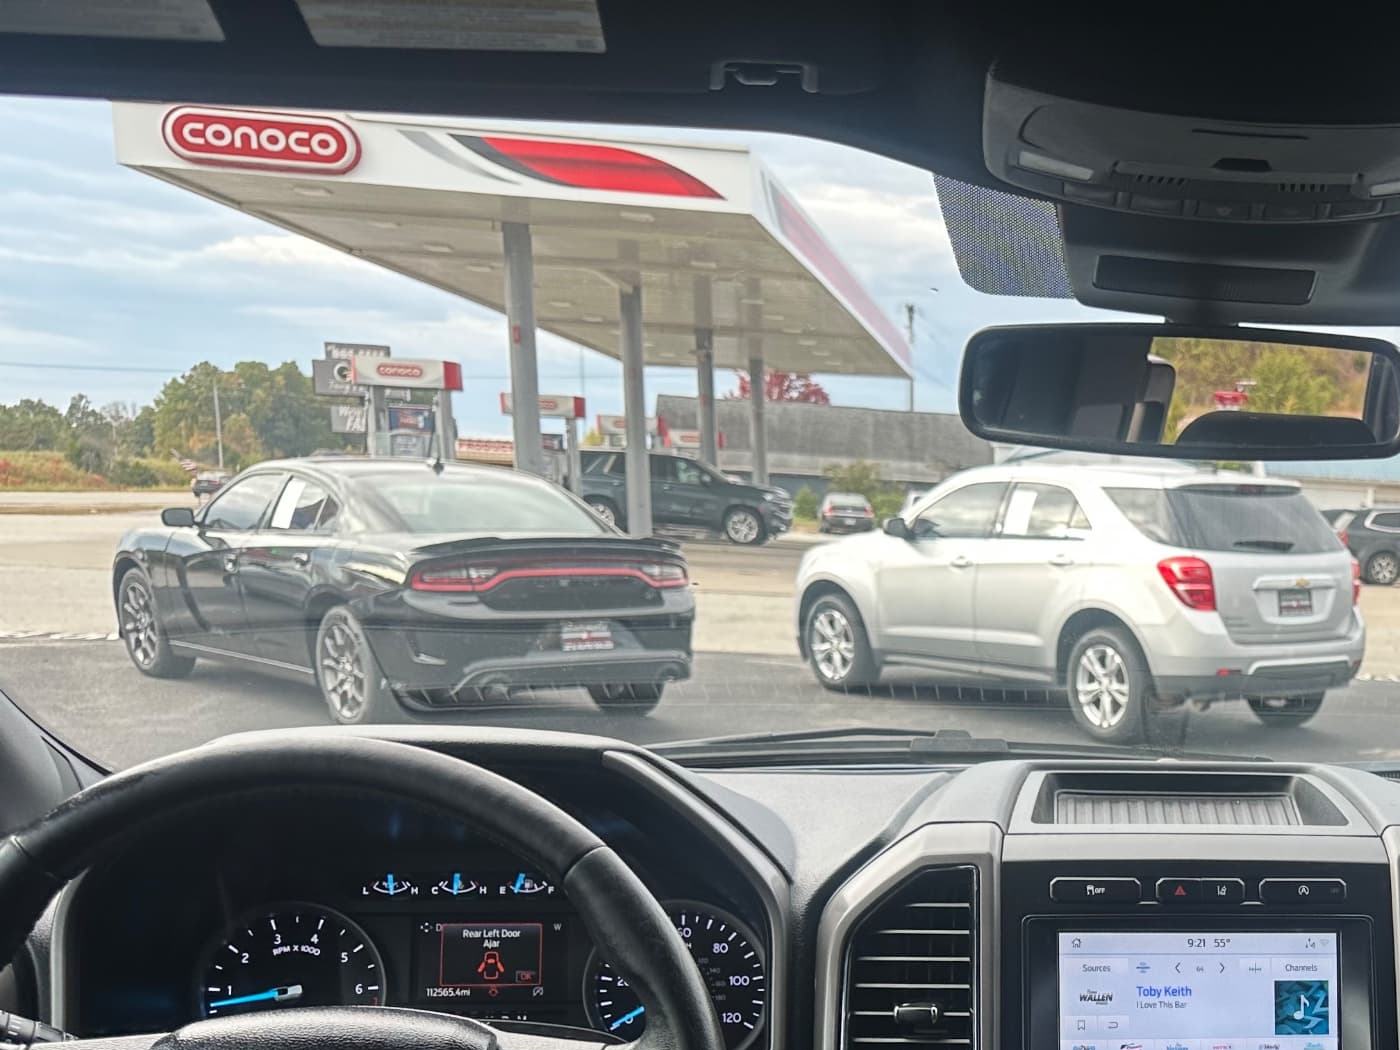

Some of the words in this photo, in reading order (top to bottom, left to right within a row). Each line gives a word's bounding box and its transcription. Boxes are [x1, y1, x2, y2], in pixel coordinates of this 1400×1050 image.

[362, 886, 369, 895] L
[411, 886, 419, 895] H
[431, 886, 439, 895] C
[479, 886, 487, 895] H
[499, 886, 506, 895] E
[548, 886, 555, 895] F
[462, 929, 482, 938] Rear
[483, 929, 500, 938] Left
[501, 929, 521, 938] Door
[273, 933, 282, 945] 3
[310, 933, 319, 945] 4
[483, 939, 500, 949] Ajar
[1187, 938, 1206, 948] 9:21
[272, 945, 291, 956] RPM
[300, 945, 321, 956] 1000
[713, 942, 728, 954] 80
[241, 953, 249, 964] 2
[340, 952, 349, 963] 5
[1081, 963, 1111, 973] Sources
[1284, 963, 1318, 972] Channels
[728, 975, 750, 986] 100
[227, 985, 232, 996] 1
[355, 983, 363, 994] 6
[1136, 986, 1162, 998] Toby
[1164, 985, 1192, 997] Keith
[1079, 993, 1113, 1002] WALLEN
[1140, 1001, 1157, 1009] Love
[1158, 1001, 1174, 1009] This
[1174, 1001, 1187, 1009] Bar
[722, 1012, 742, 1024] 120
